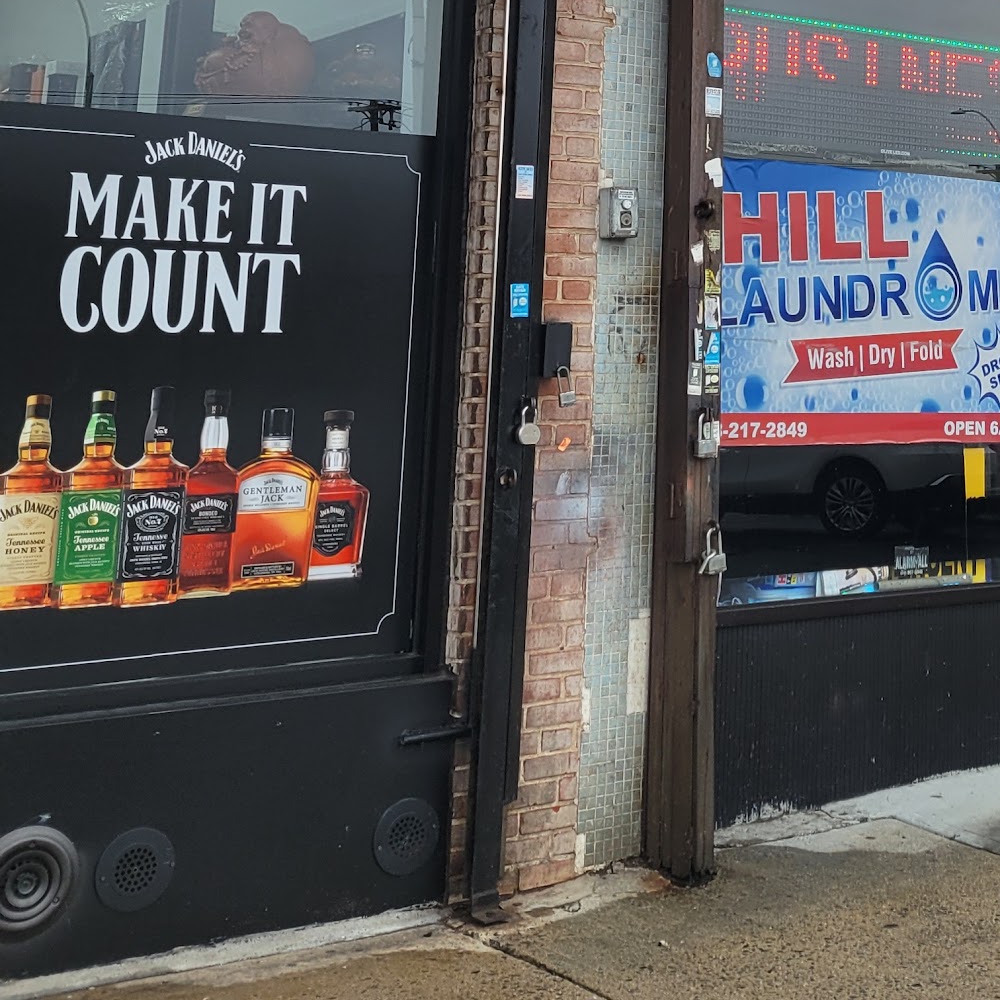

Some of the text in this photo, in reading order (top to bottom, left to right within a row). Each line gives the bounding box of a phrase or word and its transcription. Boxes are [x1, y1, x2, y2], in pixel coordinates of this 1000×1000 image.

[144, 136, 186, 165] JACK
[64, 171, 307, 246] MAKE IT
[723, 191, 909, 265] HILL
[59, 245, 301, 334] COUNT
[807, 339, 944, 372] Wash Dry Fold
[943, 420, 986, 437] OPEN
[243, 485, 303, 496] GENTLEMAN
[260, 494, 284, 503] JACK
[68, 502, 89, 520] JACK
[126, 499, 149, 518] JACK
[190, 500, 206, 513] JACK
[5, 546, 46, 555] HONEY
[74, 544, 106, 552] APPLE
